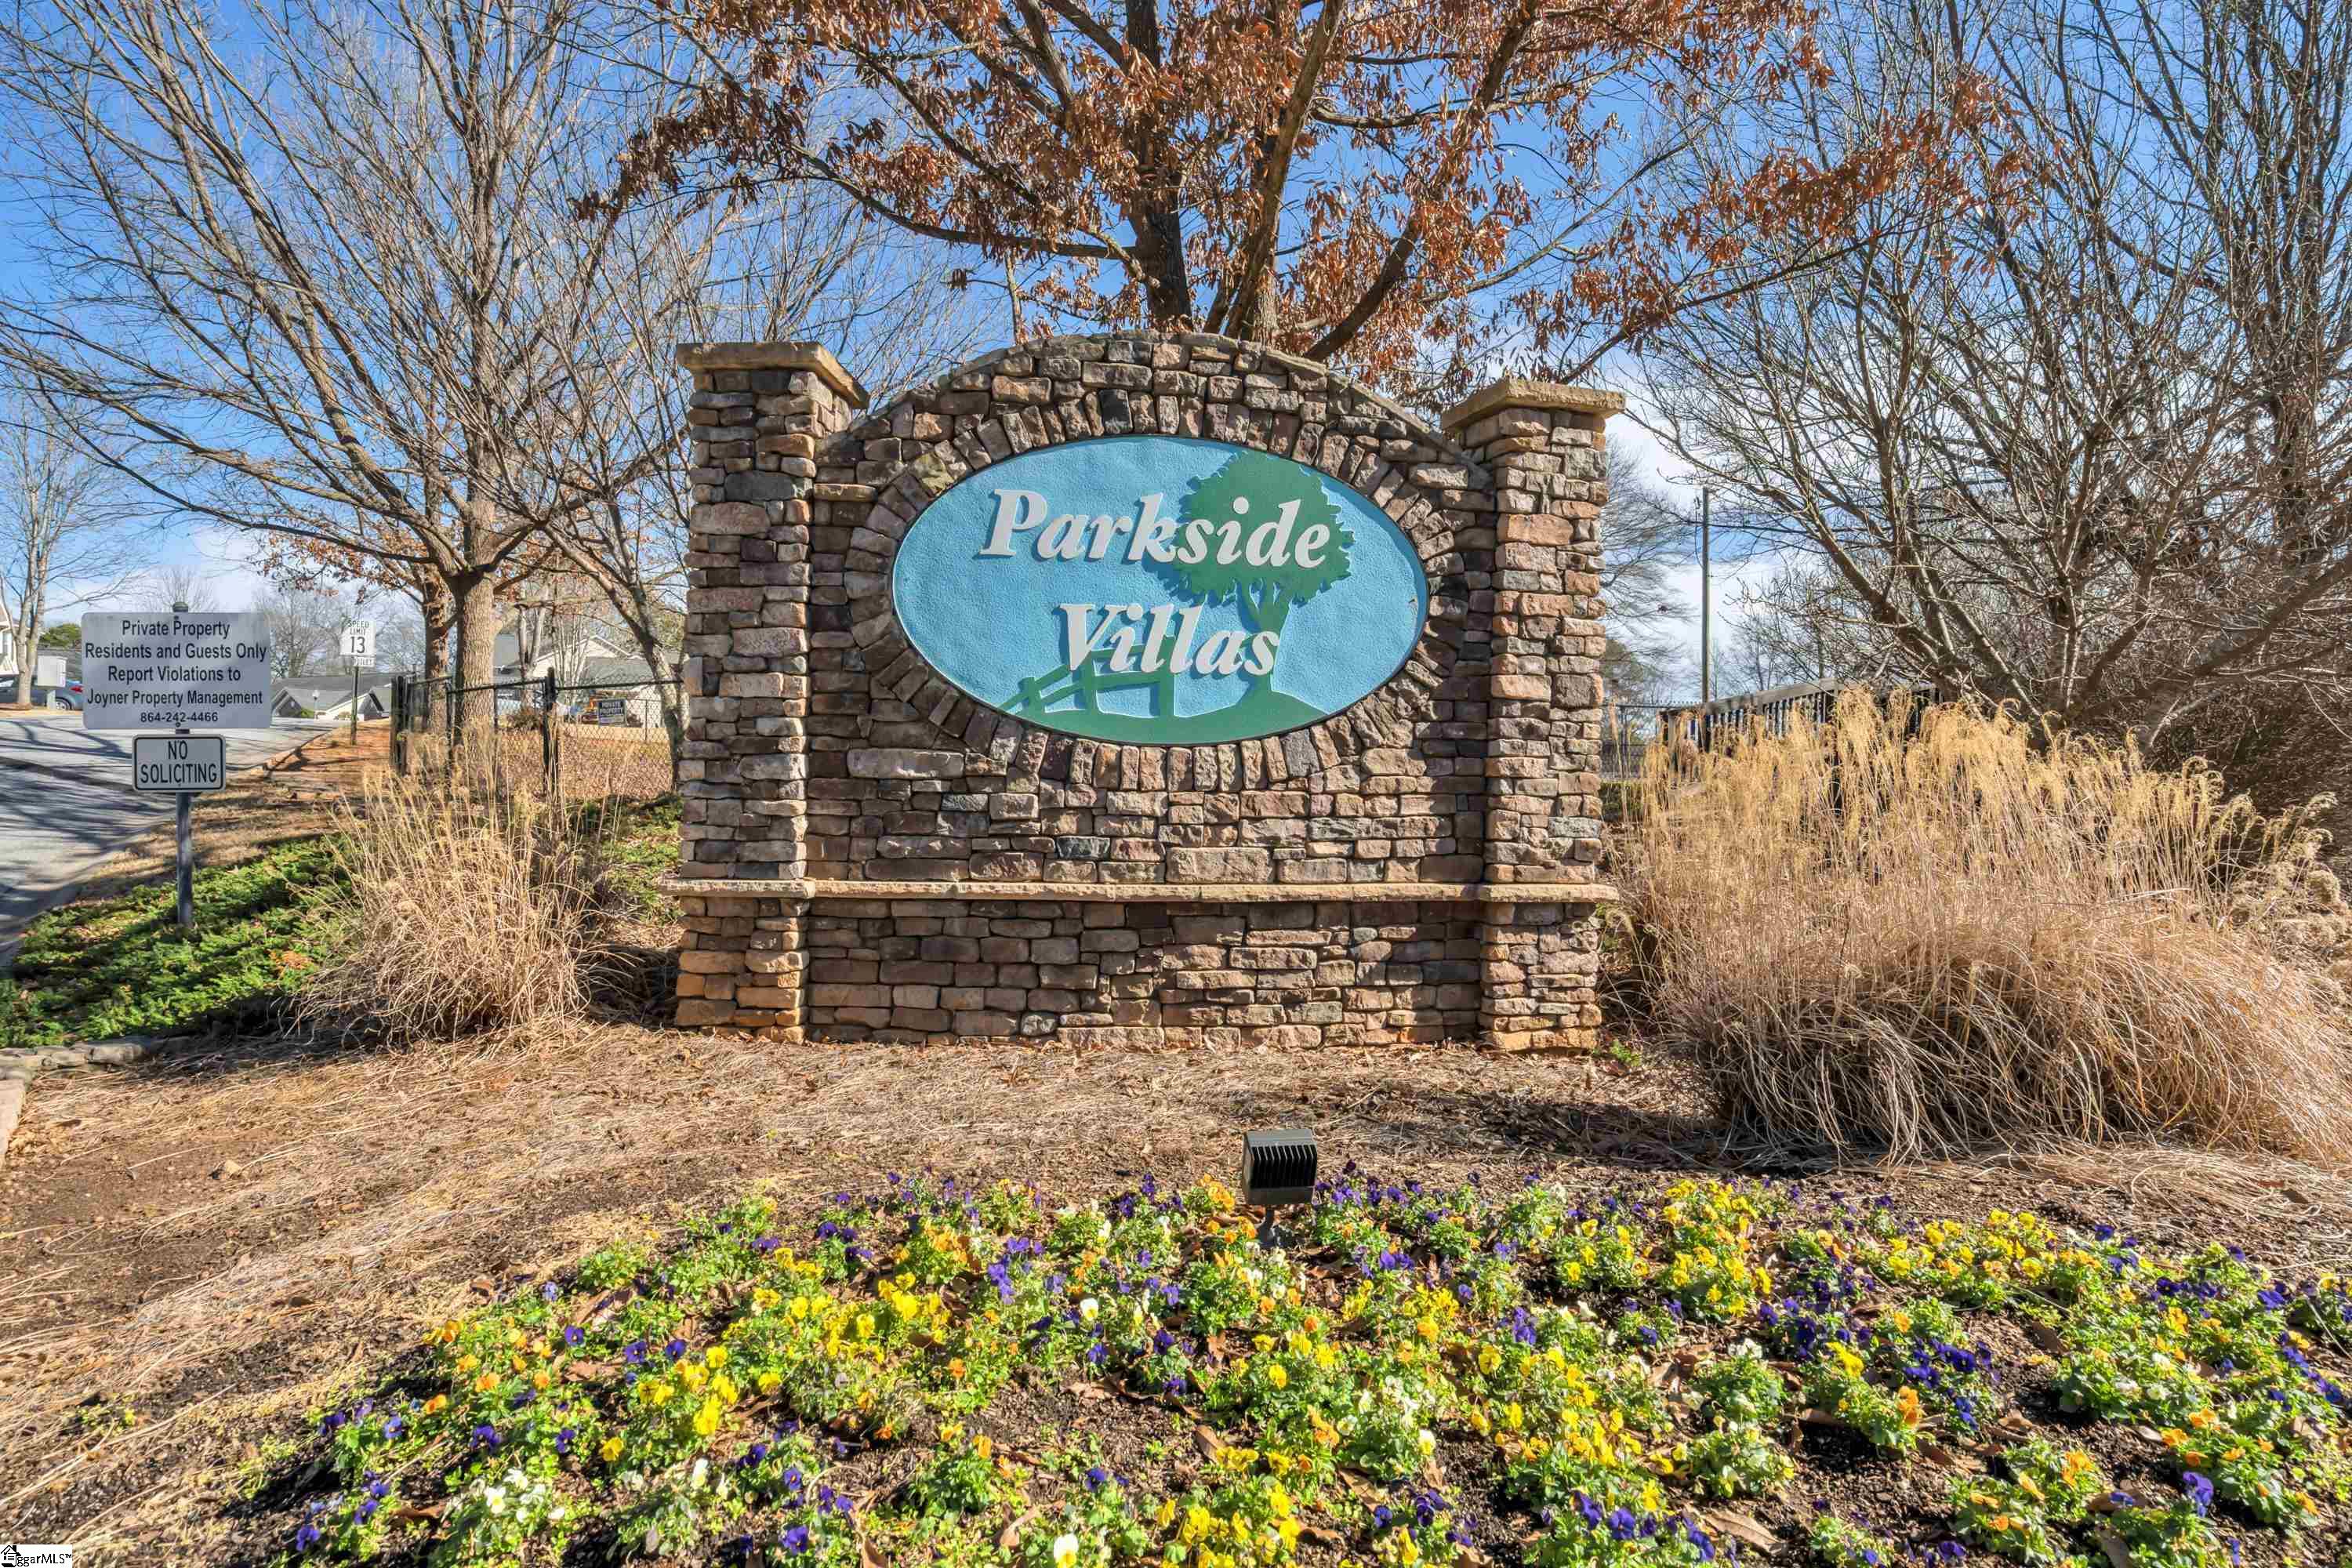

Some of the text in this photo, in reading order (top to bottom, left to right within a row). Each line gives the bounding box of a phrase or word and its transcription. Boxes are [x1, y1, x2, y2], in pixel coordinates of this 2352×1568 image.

[978, 488, 1330, 568] Parkside
[122, 620, 230, 640] Private Property
[1058, 603, 1279, 676] Villas
[85, 643, 267, 662] Residents and Guests Only
[350, 637, 365, 654] 13
[108, 666, 241, 684] Report Violations to
[87, 688, 263, 708] Joyner Property Management
[140, 712, 219, 723] 864-242-4466
[168, 740, 188, 760] NO
[140, 764, 217, 784] SOLICITING
